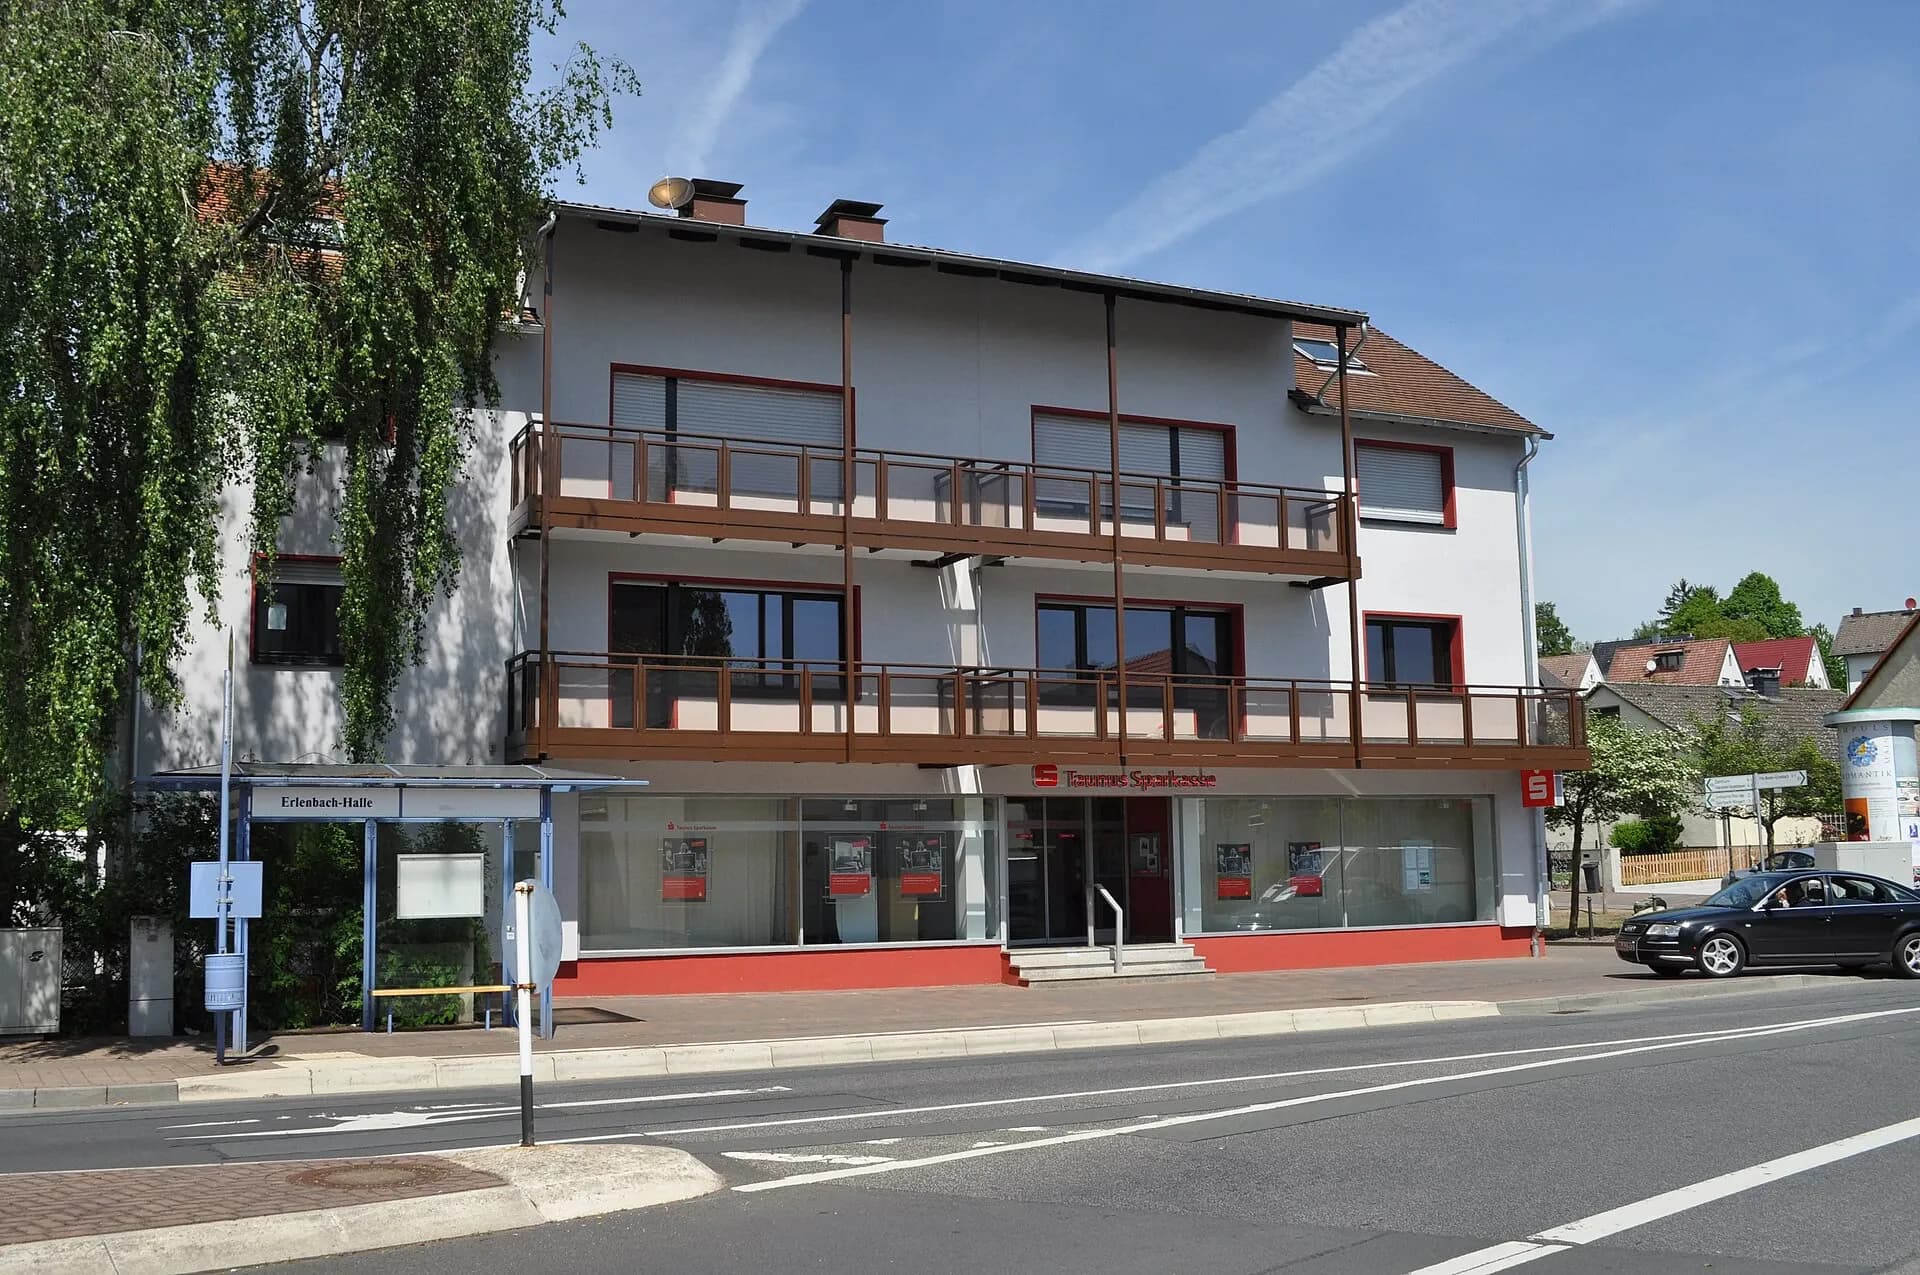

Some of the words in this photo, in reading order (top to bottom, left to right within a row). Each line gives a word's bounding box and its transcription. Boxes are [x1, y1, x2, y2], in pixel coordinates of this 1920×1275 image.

[1065, 770, 1128, 788] Taunus
[1130, 770, 1216, 792] Sparkasse
[281, 796, 373, 808] Erlenbach-Halle
